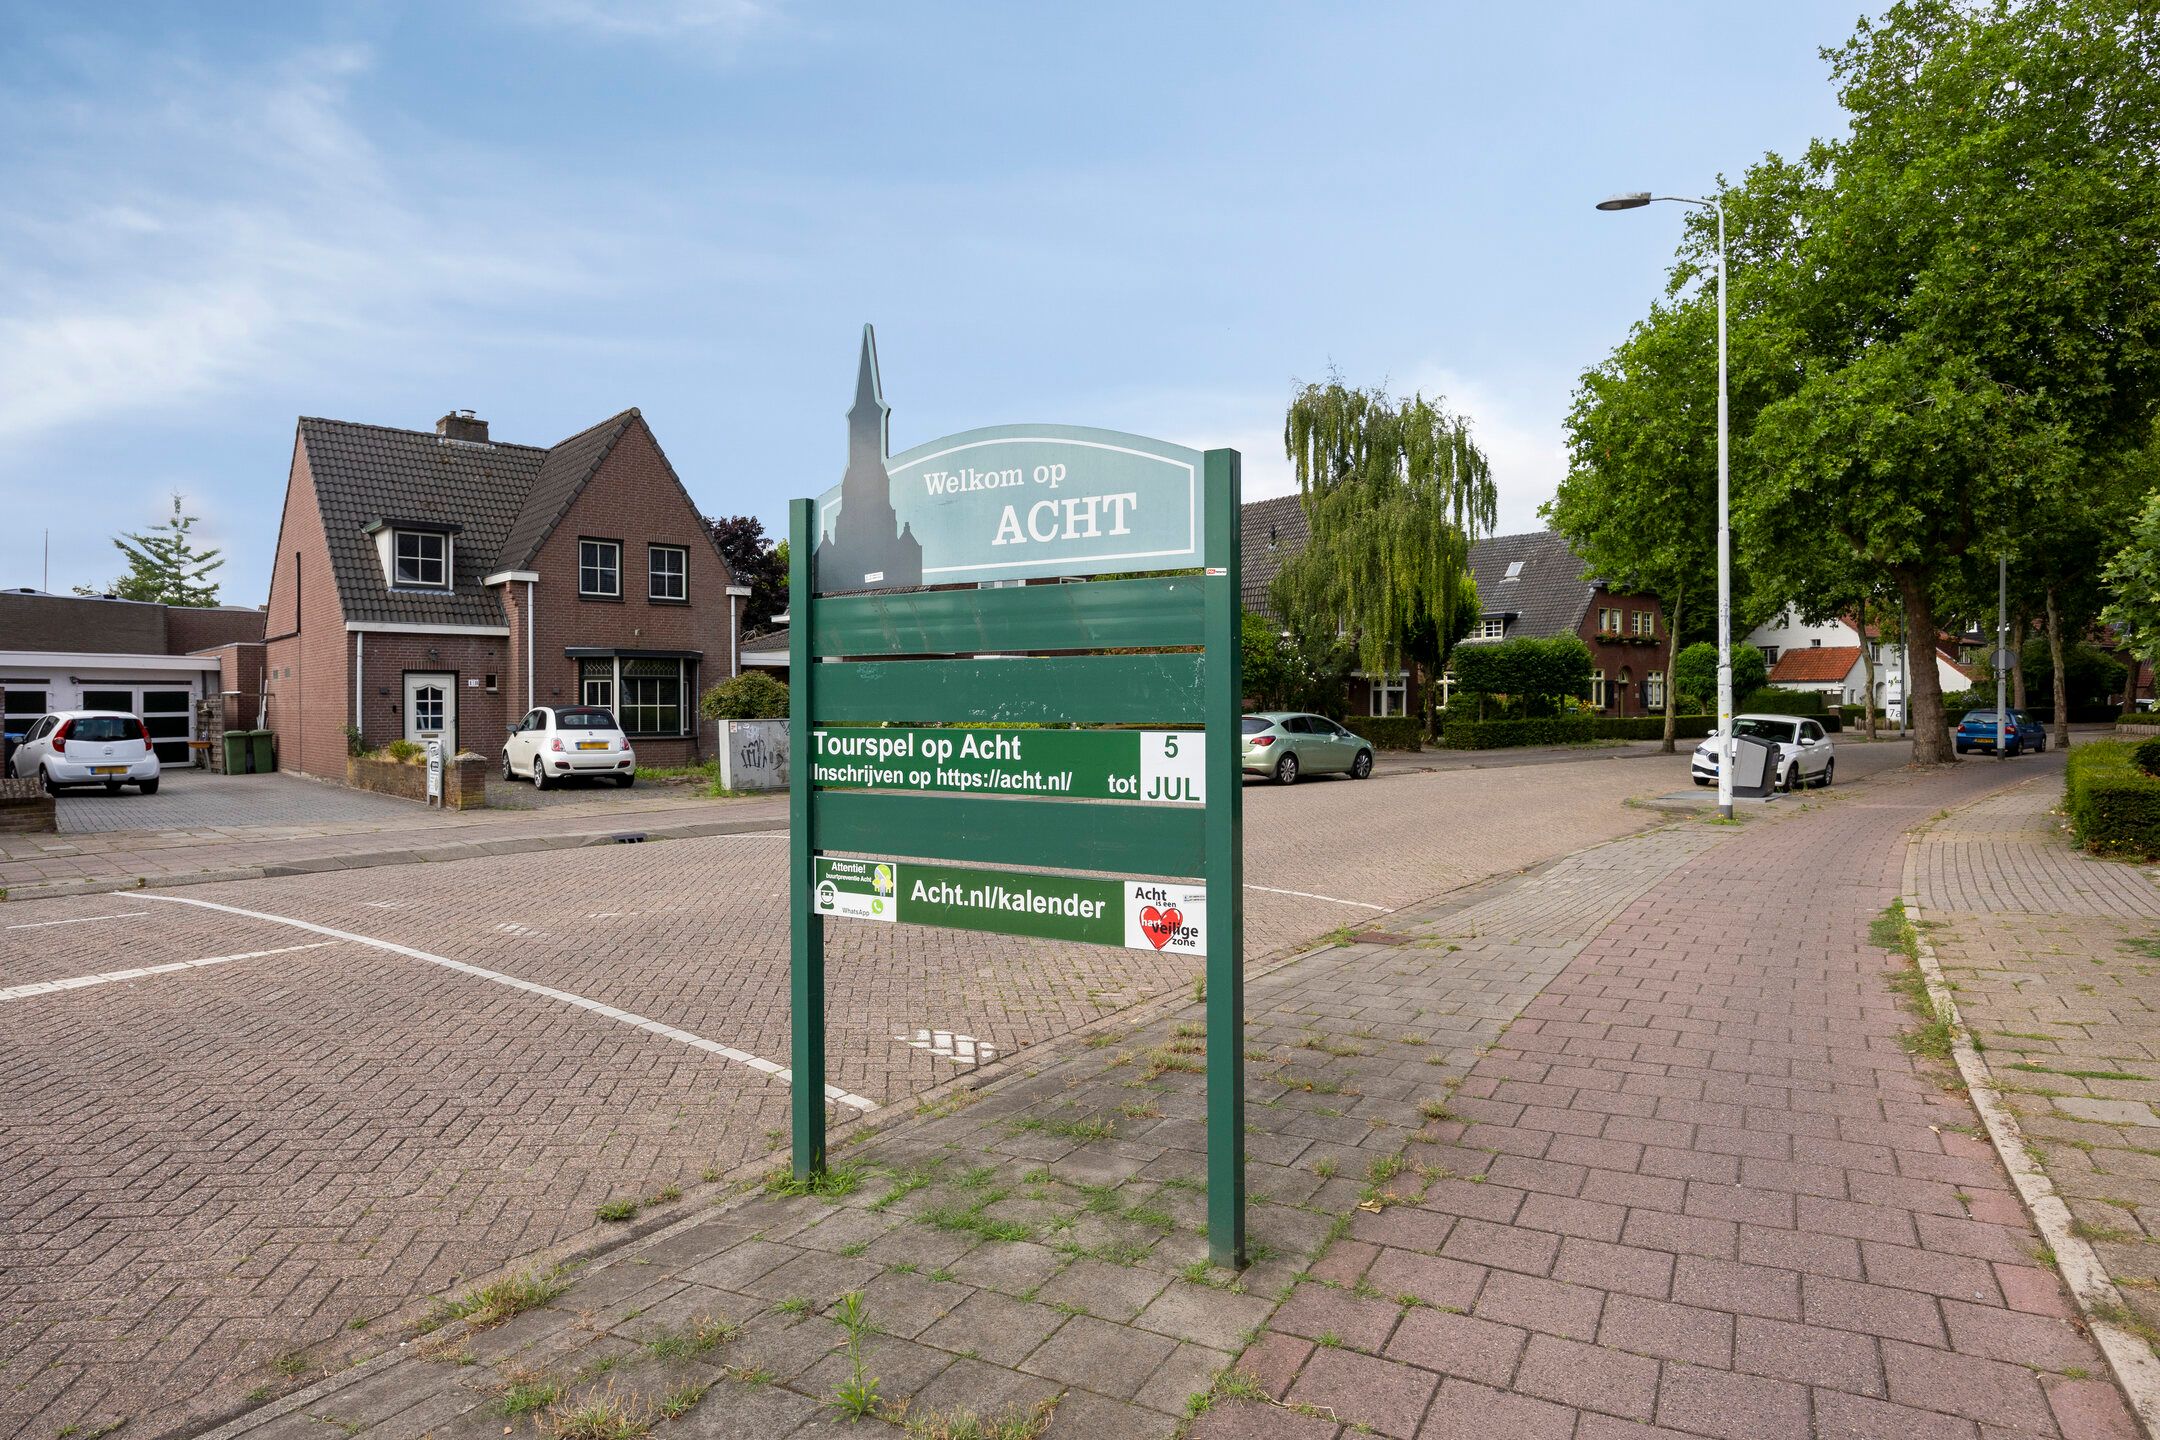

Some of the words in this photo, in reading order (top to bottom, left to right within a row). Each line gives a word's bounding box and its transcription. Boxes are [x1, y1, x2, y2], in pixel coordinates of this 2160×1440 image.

[924, 468, 1024, 496] Welkom
[1033, 463, 1067, 490] op
[991, 492, 1137, 546] ACHT
[813, 731, 914, 762] Tourspel
[921, 738, 953, 764] op
[960, 733, 1021, 760] Acht
[1164, 735, 1179, 758] 5
[813, 763, 904, 787] Inschrijven
[908, 770, 931, 789] op
[937, 767, 1073, 791] https://acht.nl/
[1108, 774, 1137, 794] tot
[1147, 776, 1200, 801] JUL
[831, 861, 866, 874] Attentie!
[911, 879, 1106, 919] Acht.nl/kalender
[1135, 887, 1167, 901] Acht
[842, 907, 870, 917] WhatsApp
[1152, 921, 1199, 940] veilige
[1172, 938, 1196, 947] zone
